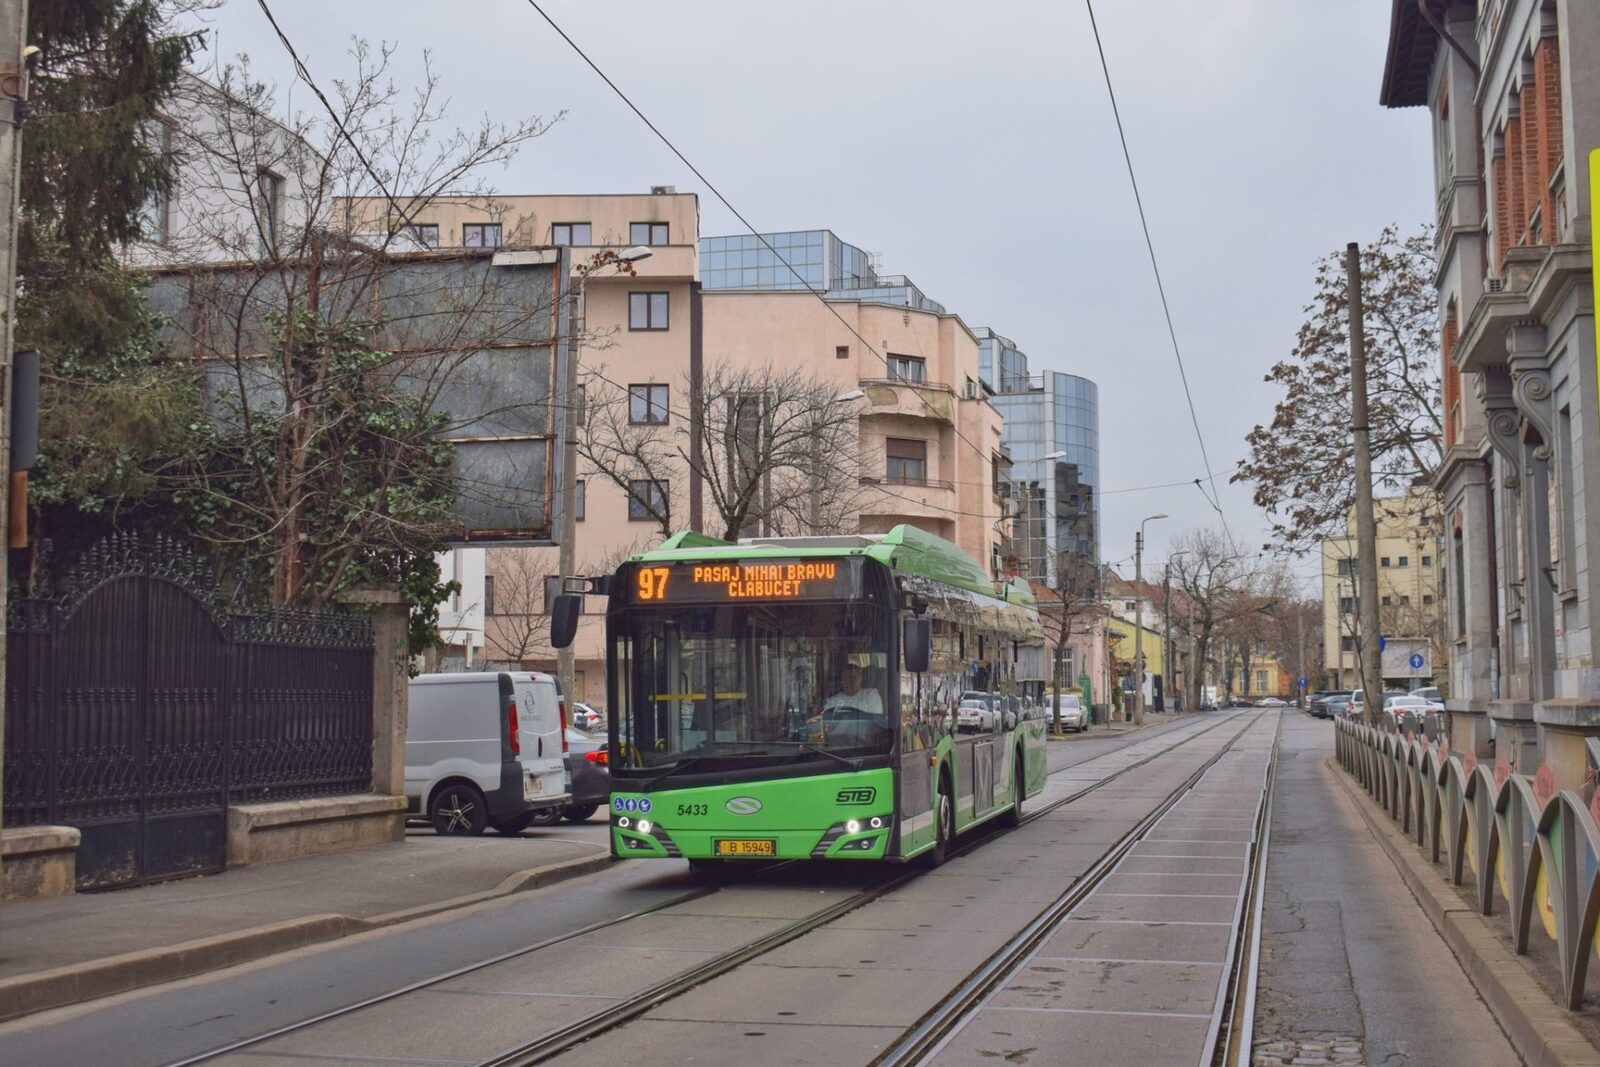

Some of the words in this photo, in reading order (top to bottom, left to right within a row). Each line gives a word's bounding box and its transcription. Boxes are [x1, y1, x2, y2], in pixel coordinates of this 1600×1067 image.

[694, 567, 740, 583] PASAJ
[744, 564, 782, 581] MIHAI
[787, 563, 835, 580] BRAVU
[638, 568, 669, 599] 97
[728, 581, 801, 597] CLABUCET
[836, 790, 872, 803] STB
[677, 804, 708, 816] 5433
[730, 842, 737, 852] B
[742, 842, 771, 852] 15949
